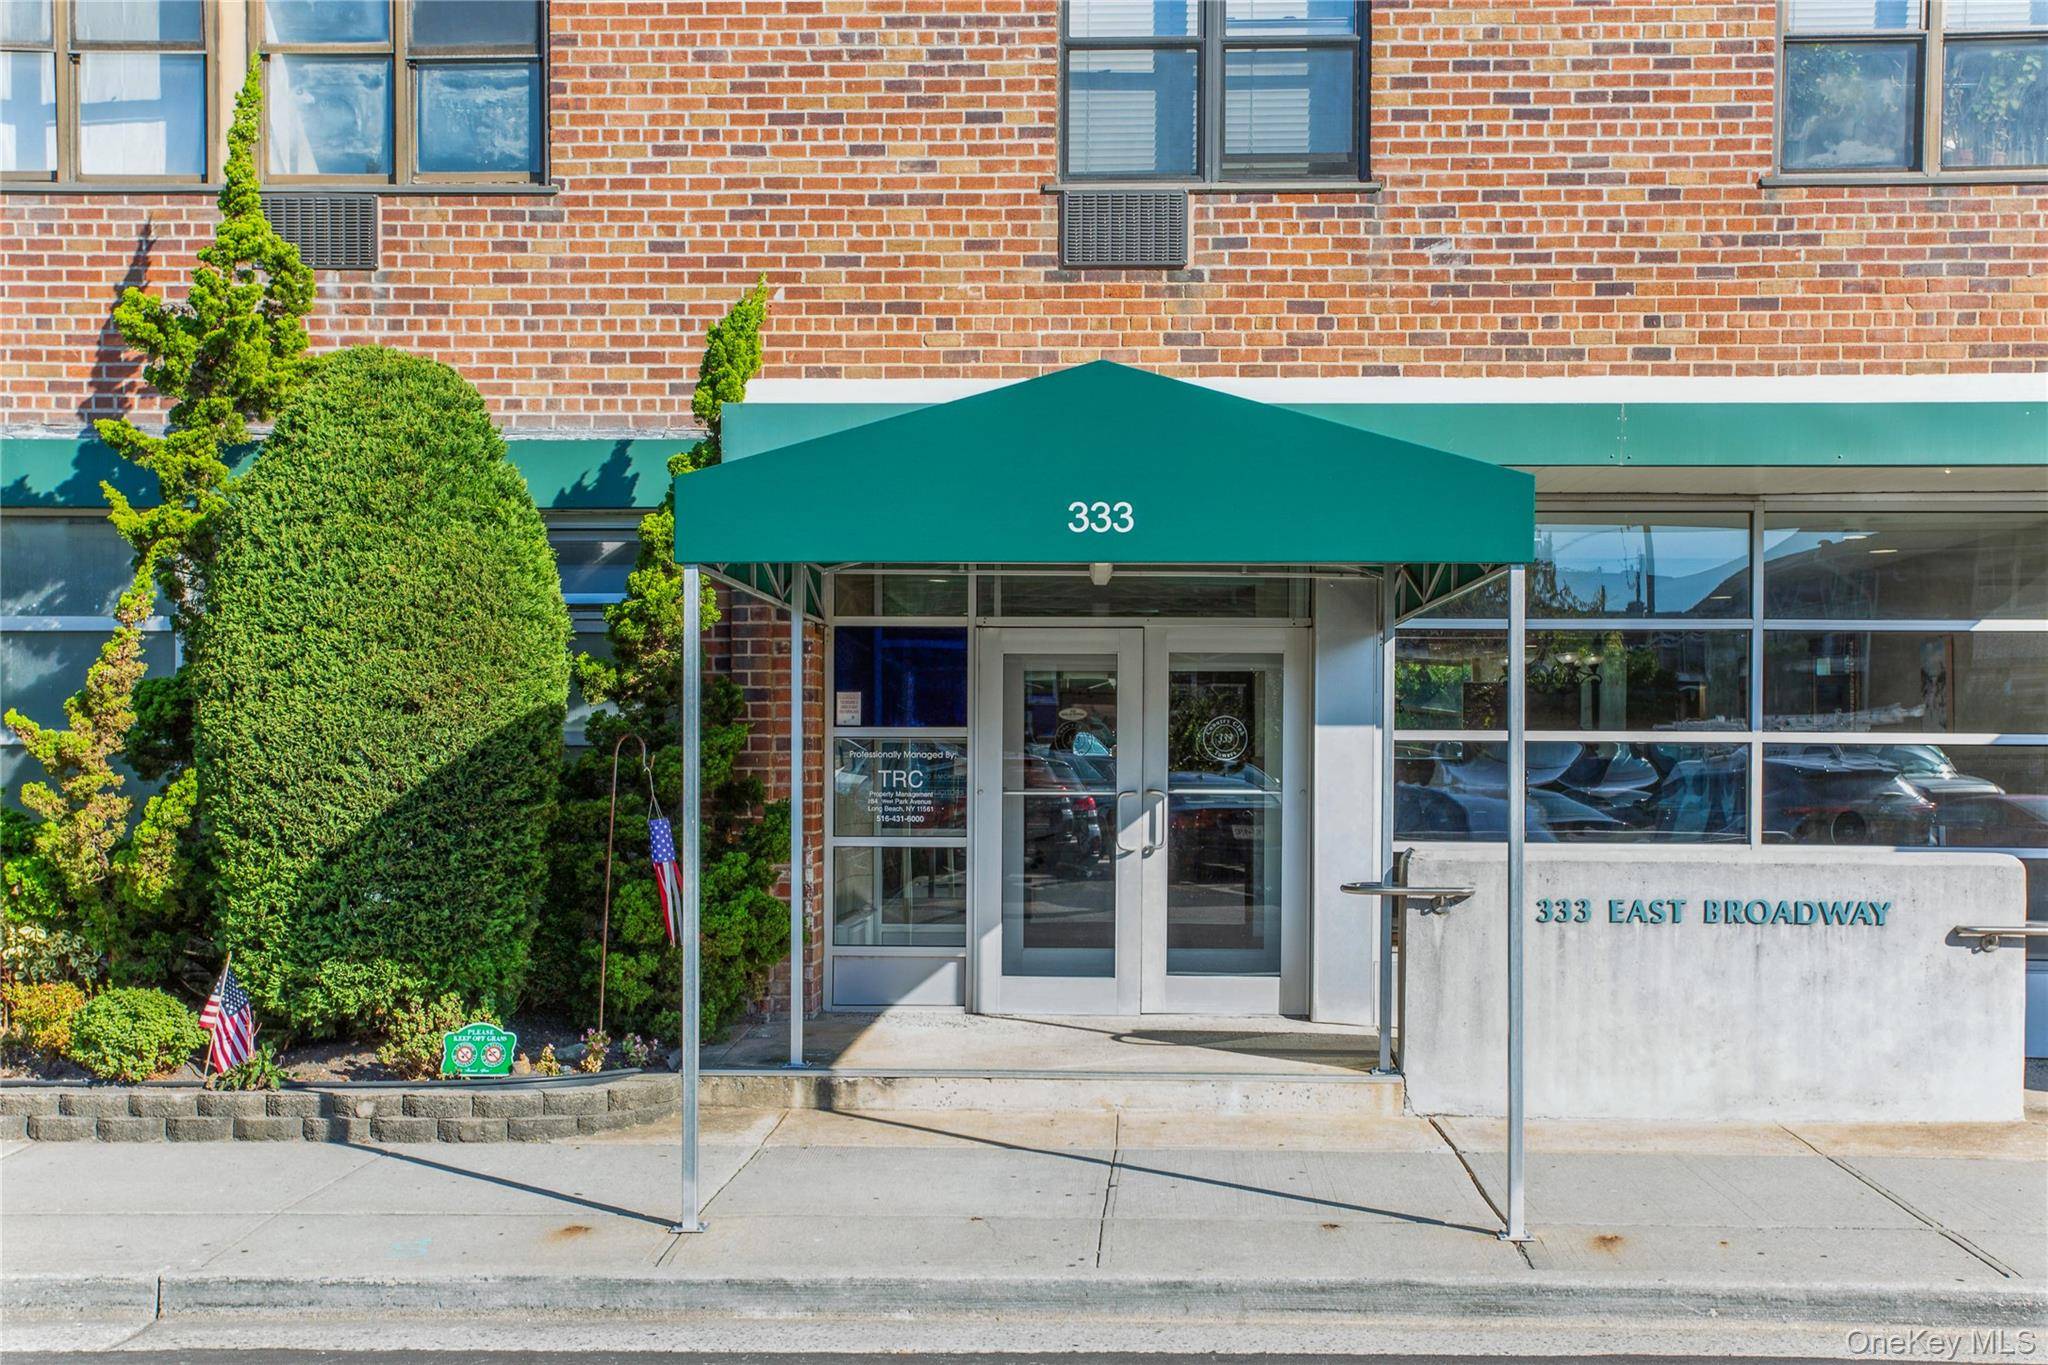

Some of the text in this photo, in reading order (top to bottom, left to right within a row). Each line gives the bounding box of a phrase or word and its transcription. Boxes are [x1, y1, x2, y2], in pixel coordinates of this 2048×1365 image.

[1067, 501, 1135, 533] 333
[849, 751, 901, 760] Professionally
[904, 751, 943, 760] Managed
[878, 770, 924, 788] TRC
[876, 815, 925, 823] 516-431-6000
[1535, 898, 1892, 926] 333 EAST BROADWAY
